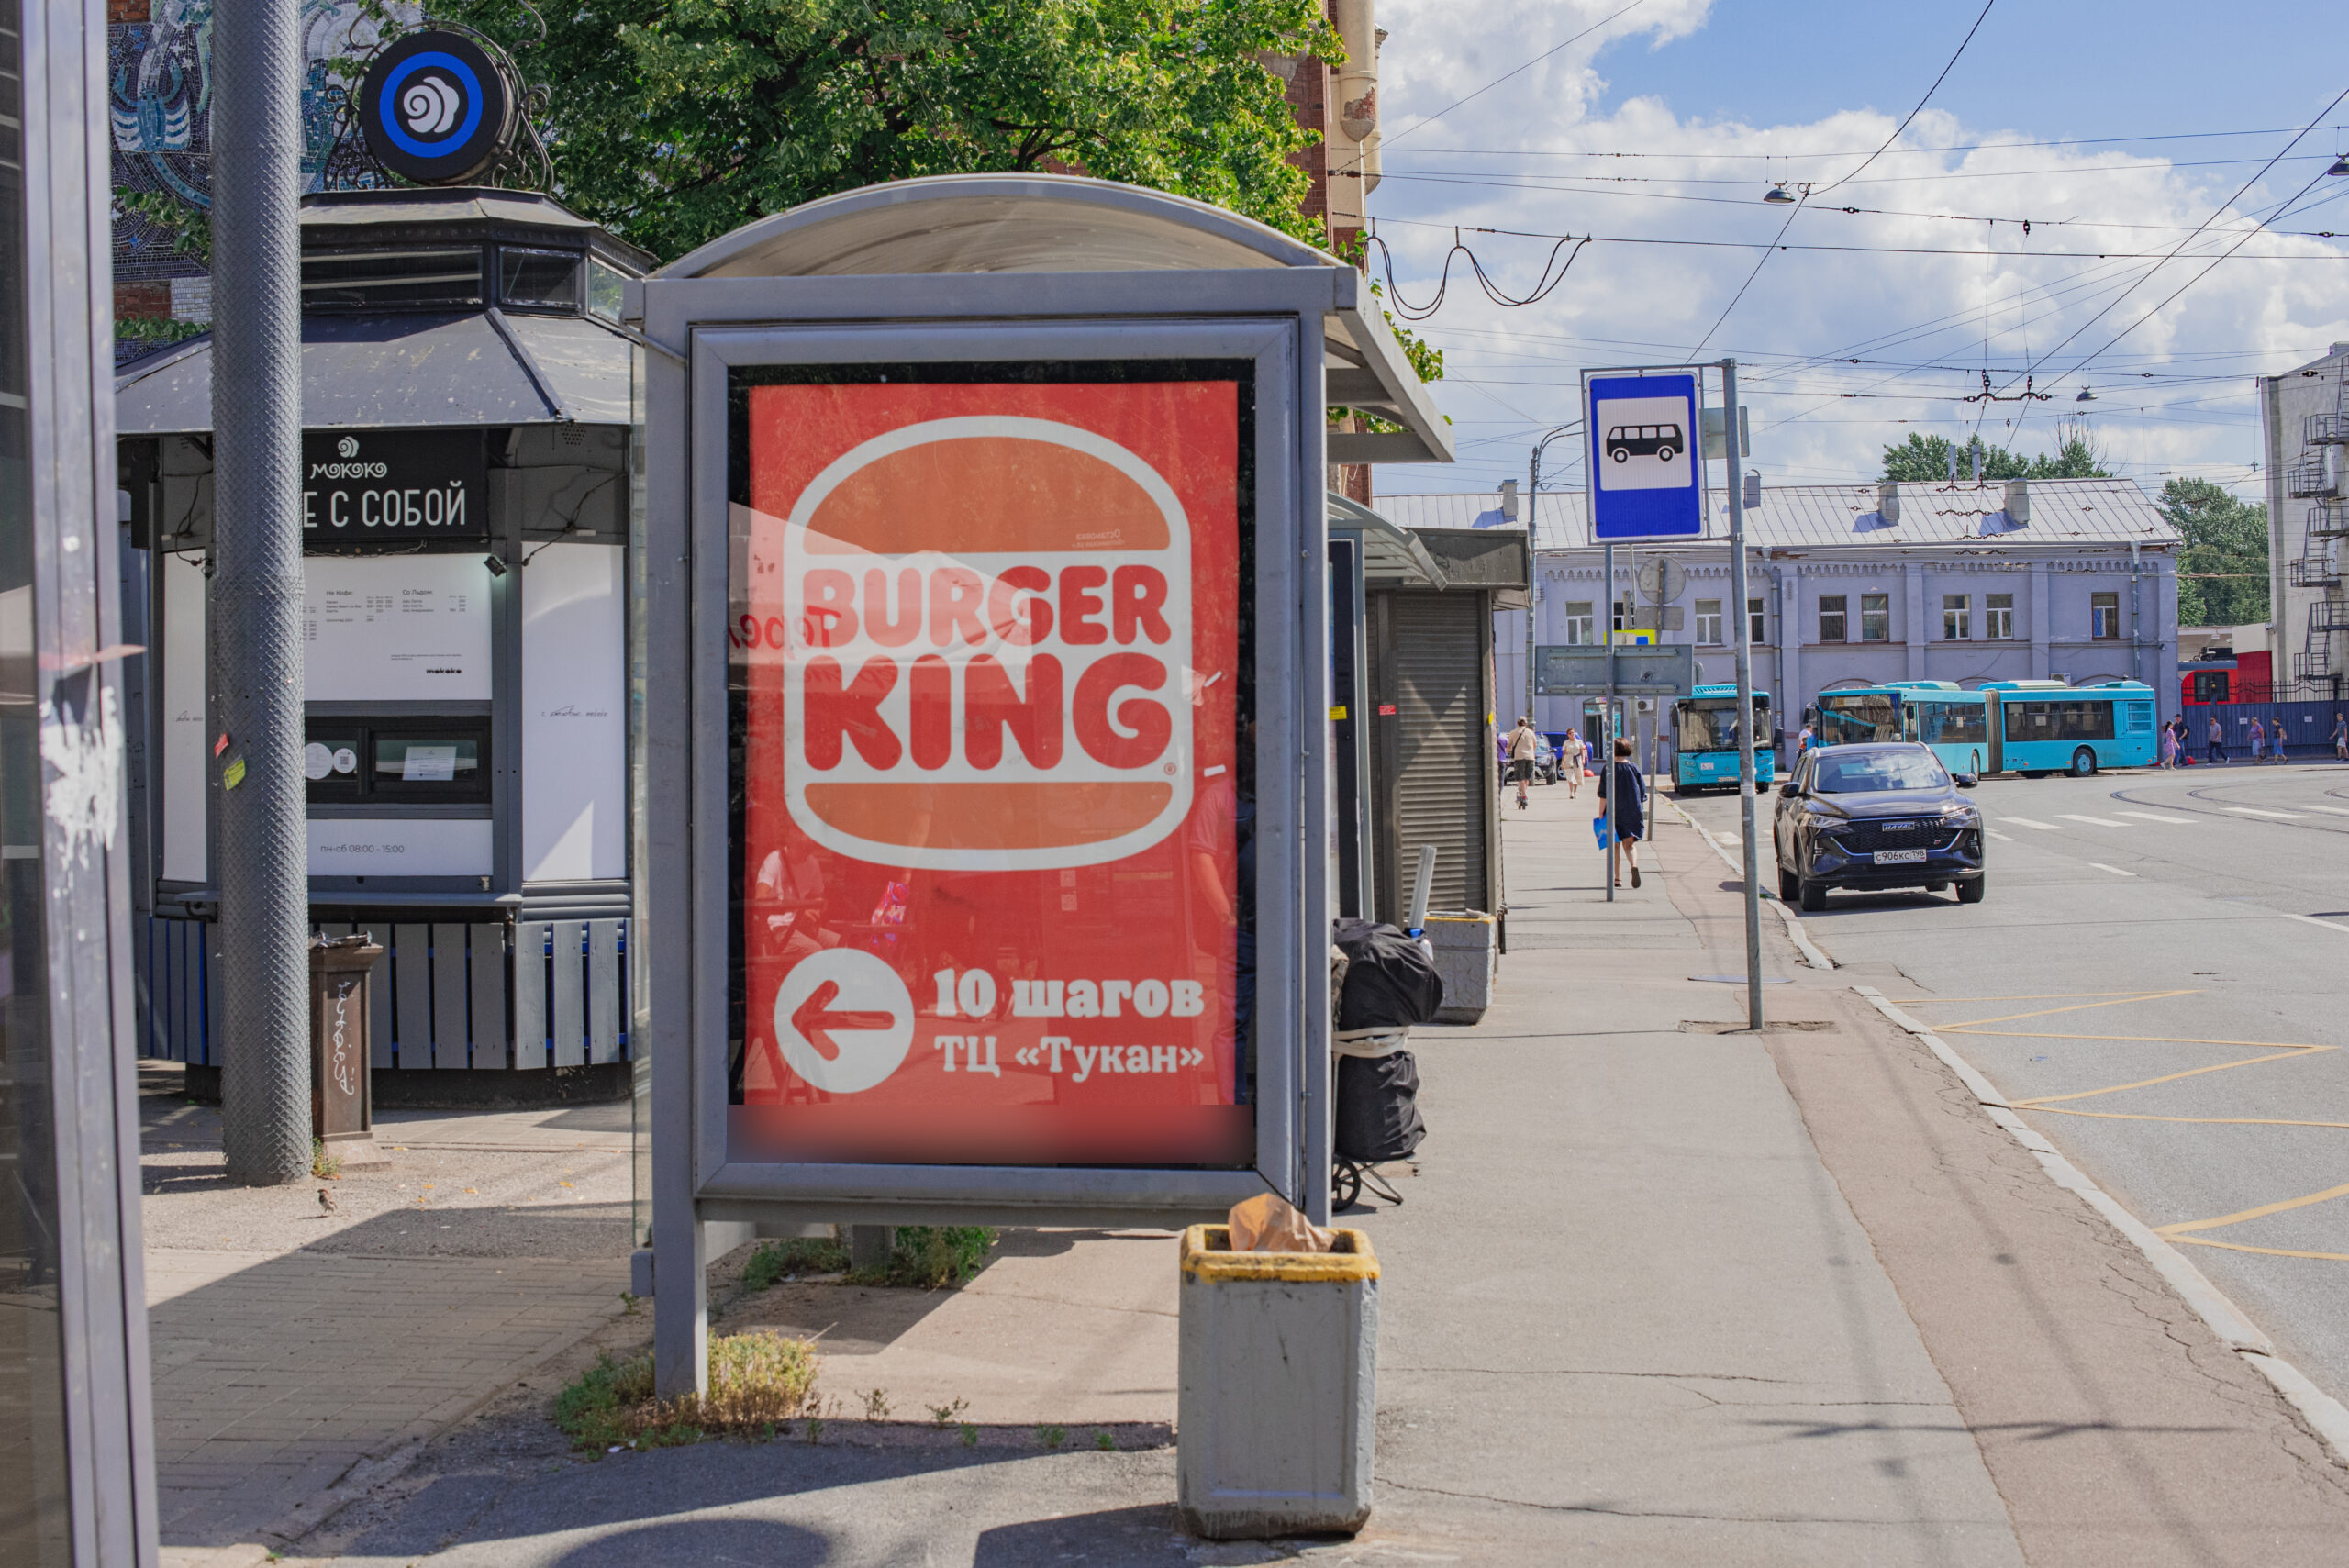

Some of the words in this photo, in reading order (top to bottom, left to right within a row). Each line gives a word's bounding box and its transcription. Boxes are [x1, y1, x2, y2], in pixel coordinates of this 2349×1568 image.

[330, 490, 350, 528] С
[362, 480, 466, 527] СОБОЙ
[802, 564, 1171, 648] BURGER
[803, 652, 1173, 771] KING
[349, 844, 374, 853] 08:00
[383, 844, 405, 853] 15:00
[934, 968, 997, 1018] 10
[1014, 978, 1205, 1018] шагов
[934, 1035, 1002, 1078] ТЦ
[1015, 1035, 1205, 1084] «Тукан»
